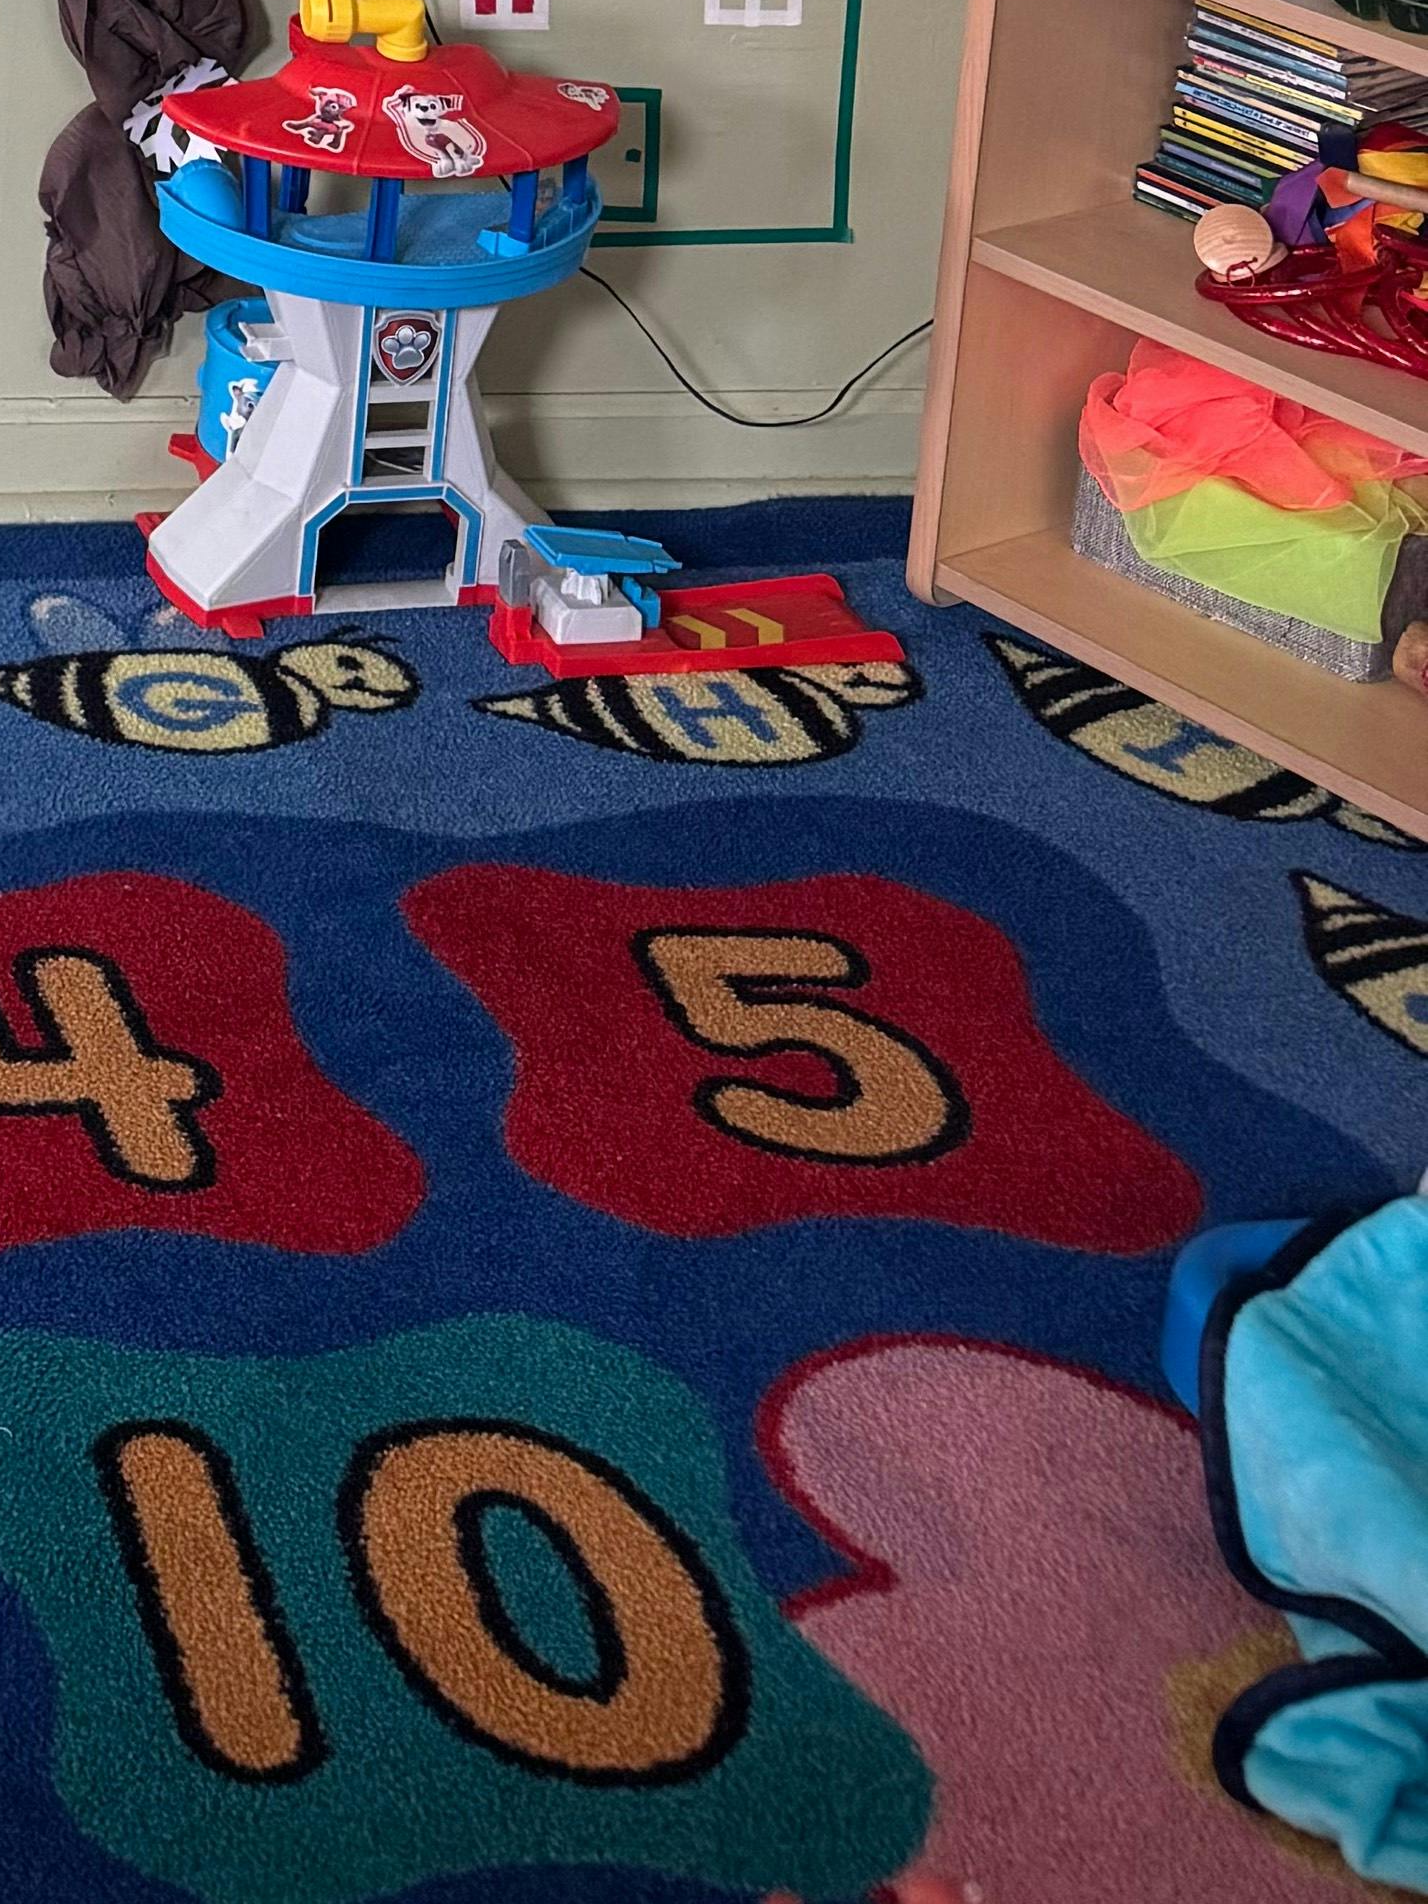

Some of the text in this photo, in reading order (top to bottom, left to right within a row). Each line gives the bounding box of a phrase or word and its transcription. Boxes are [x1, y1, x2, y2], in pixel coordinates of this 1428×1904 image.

[114, 671, 263, 732] G
[659, 683, 779, 748] H
[636, 926, 969, 1165] 5
[94, 1418, 752, 1789] 10
